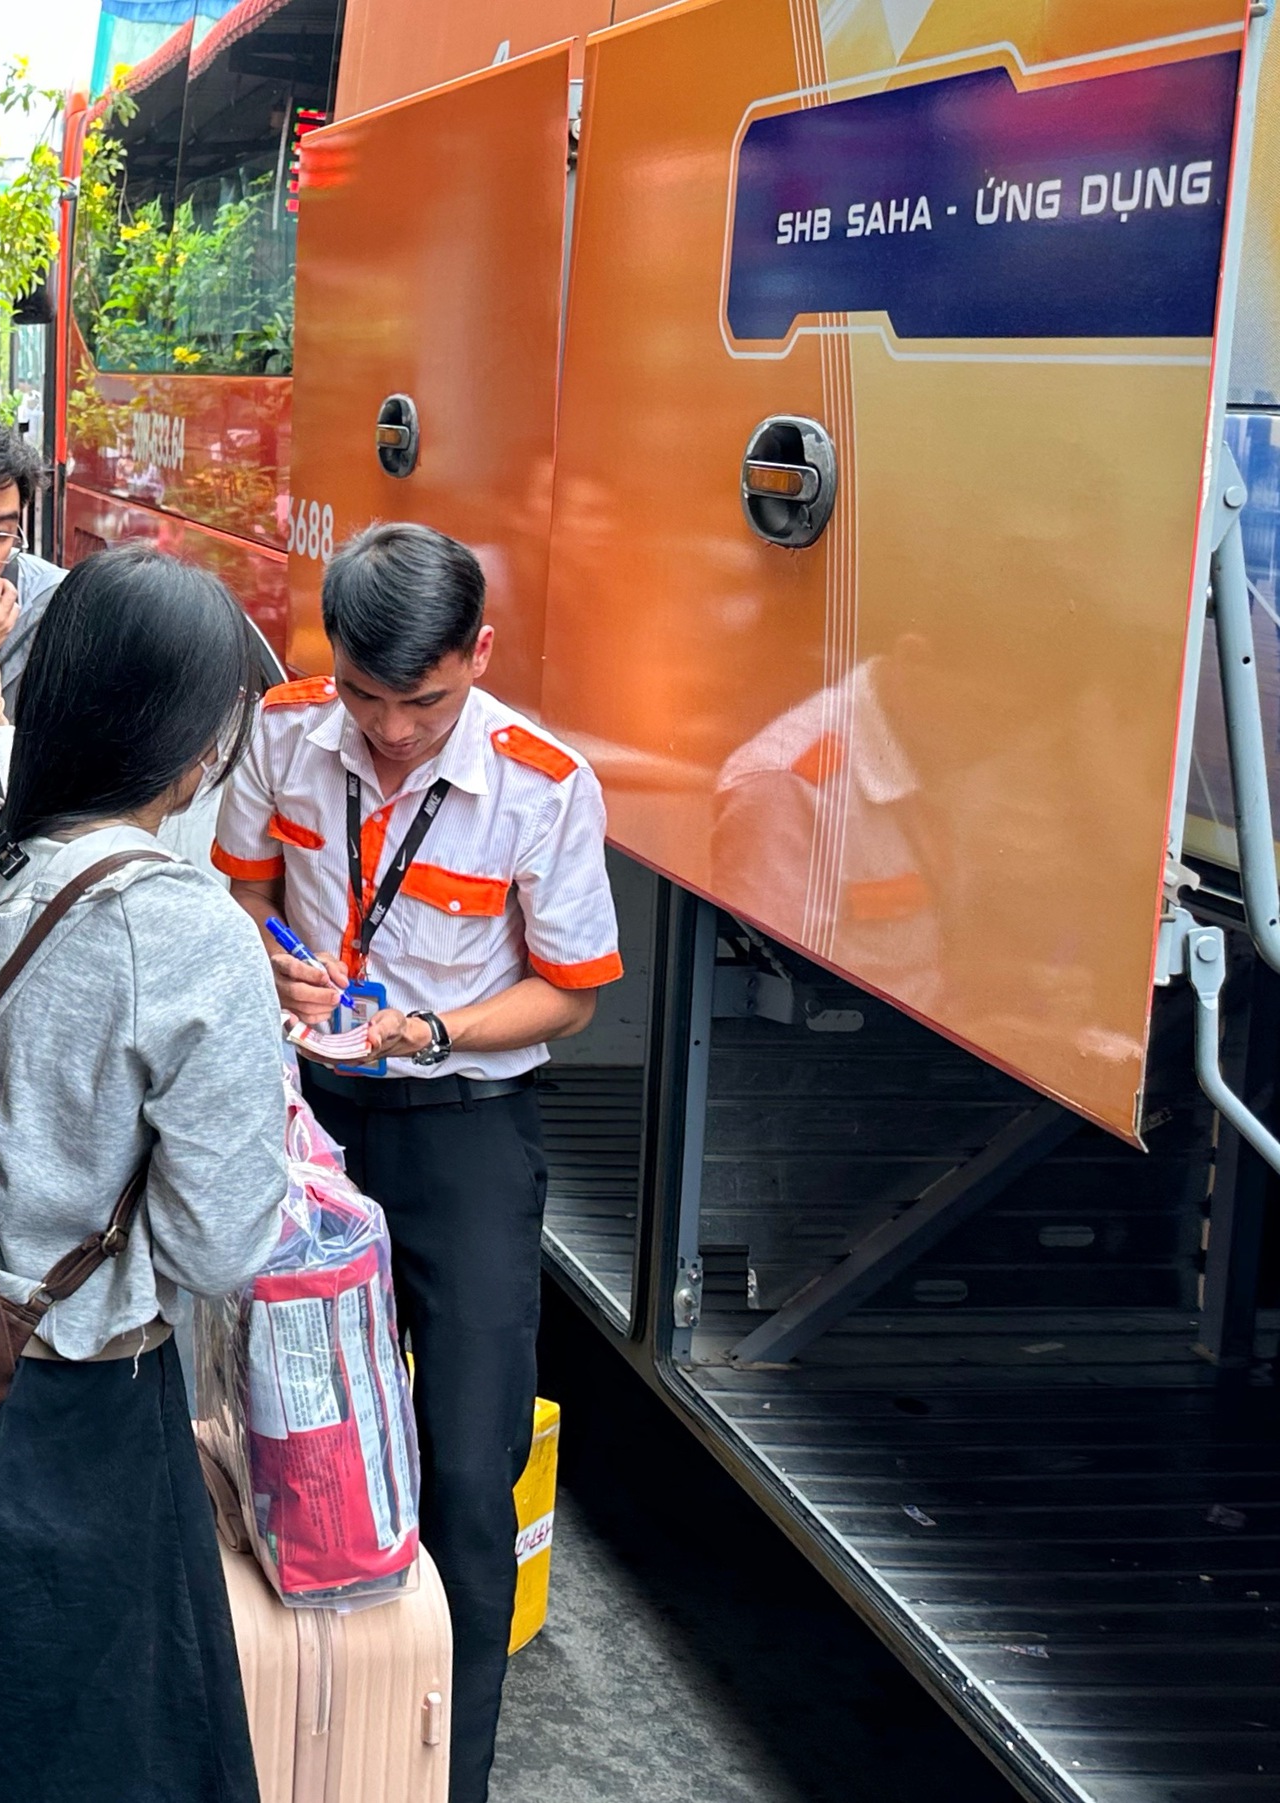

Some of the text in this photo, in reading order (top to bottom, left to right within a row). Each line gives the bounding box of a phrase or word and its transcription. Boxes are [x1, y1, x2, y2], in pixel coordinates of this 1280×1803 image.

[776, 207, 831, 245] SHB
[846, 195, 932, 238] SAHA
[975, 178, 1062, 226] ỨNG
[1080, 160, 1213, 223] DỤNG
[348, 774, 359, 798] NIKE
[423, 791, 442, 818] NIKE
[369, 901, 386, 926] NIKE
